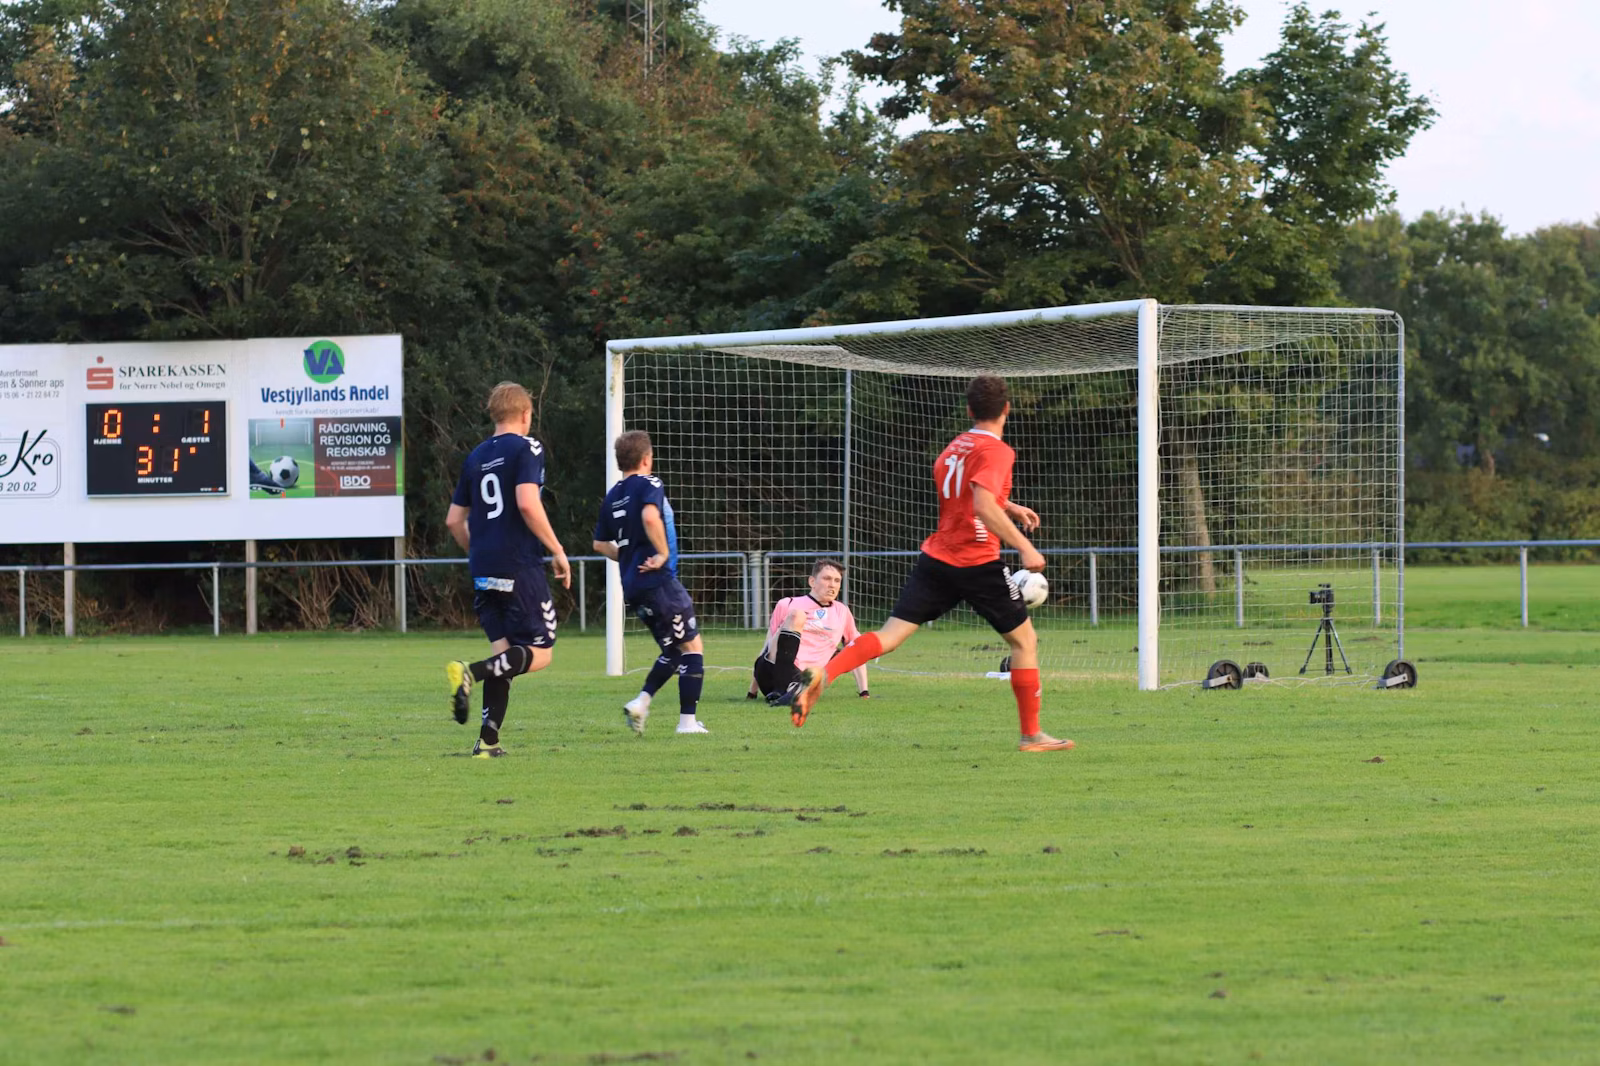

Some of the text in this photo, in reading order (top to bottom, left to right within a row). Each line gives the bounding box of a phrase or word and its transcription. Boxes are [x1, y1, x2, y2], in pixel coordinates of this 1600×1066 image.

[119, 363, 226, 378] SPAREKASSEN
[11, 379, 16, 388] &
[19, 378, 47, 389] Sønner
[50, 379, 65, 390] aps
[120, 381, 132, 390] for
[134, 381, 158, 390] Nørre
[160, 381, 183, 390] Nebel
[196, 380, 226, 390] Omegn
[261, 385, 389, 405] Vestjyllands Andel
[104, 409, 122, 438] 0
[203, 410, 210, 434] 1
[320, 434, 391, 445] REVISION OG
[326, 446, 386, 457] REGNSKAB
[7, 481, 20, 492] 20
[23, 481, 37, 492] 02
[343, 475, 371, 487] BDO
[481, 472, 504, 520] 9
